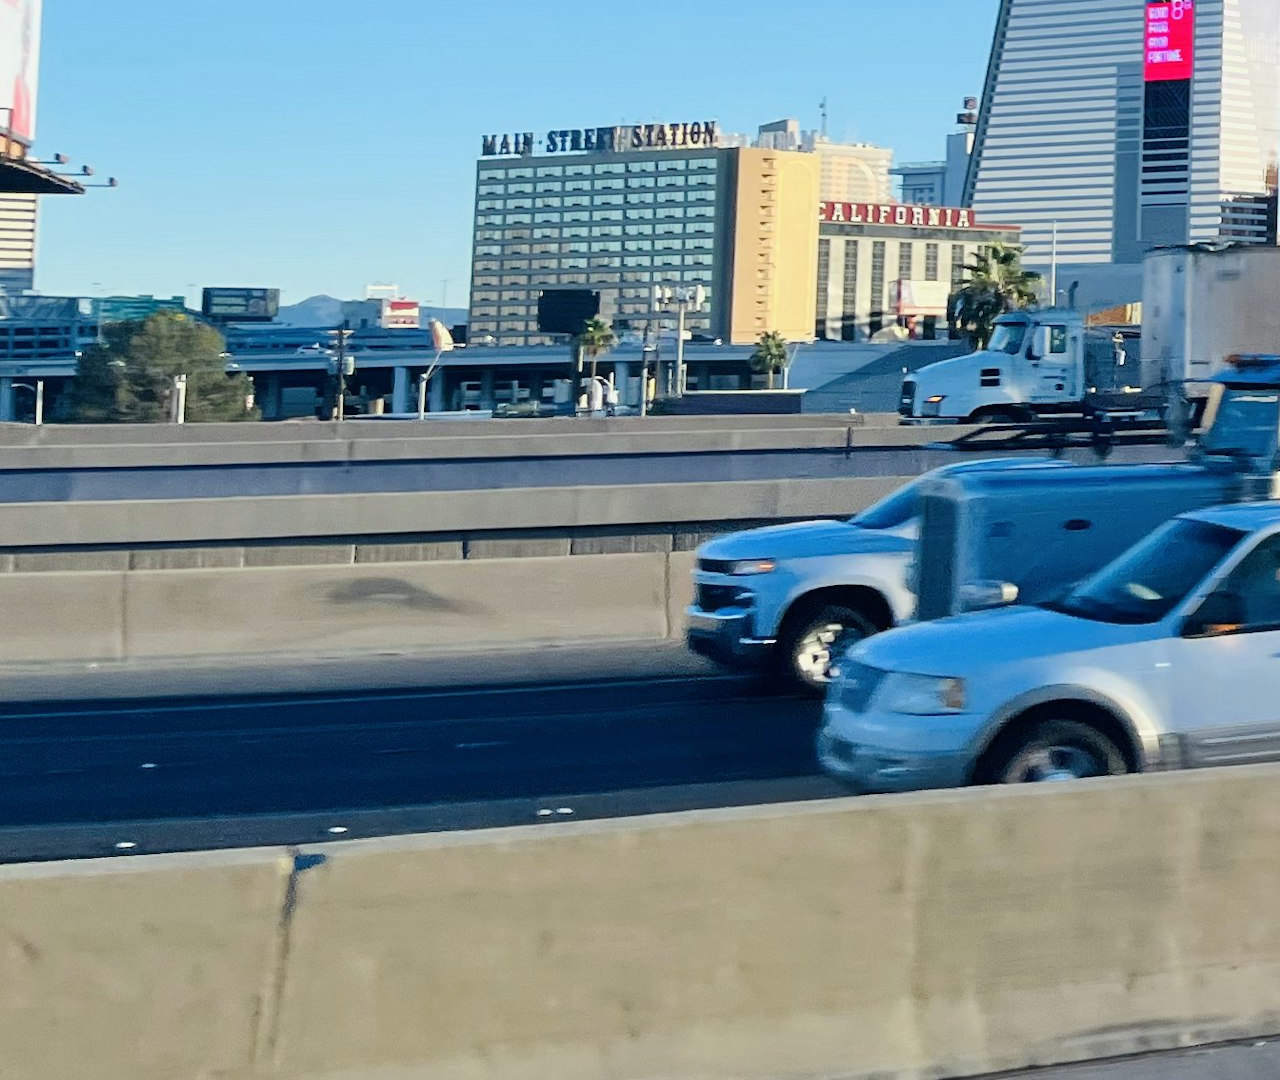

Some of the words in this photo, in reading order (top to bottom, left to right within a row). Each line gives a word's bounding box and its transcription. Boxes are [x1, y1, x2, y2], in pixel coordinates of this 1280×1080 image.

[482, 132, 533, 155] MAIN
[546, 126, 615, 152] STREET
[632, 120, 716, 147] STATION
[819, 202, 970, 228] CALIFORNIA
